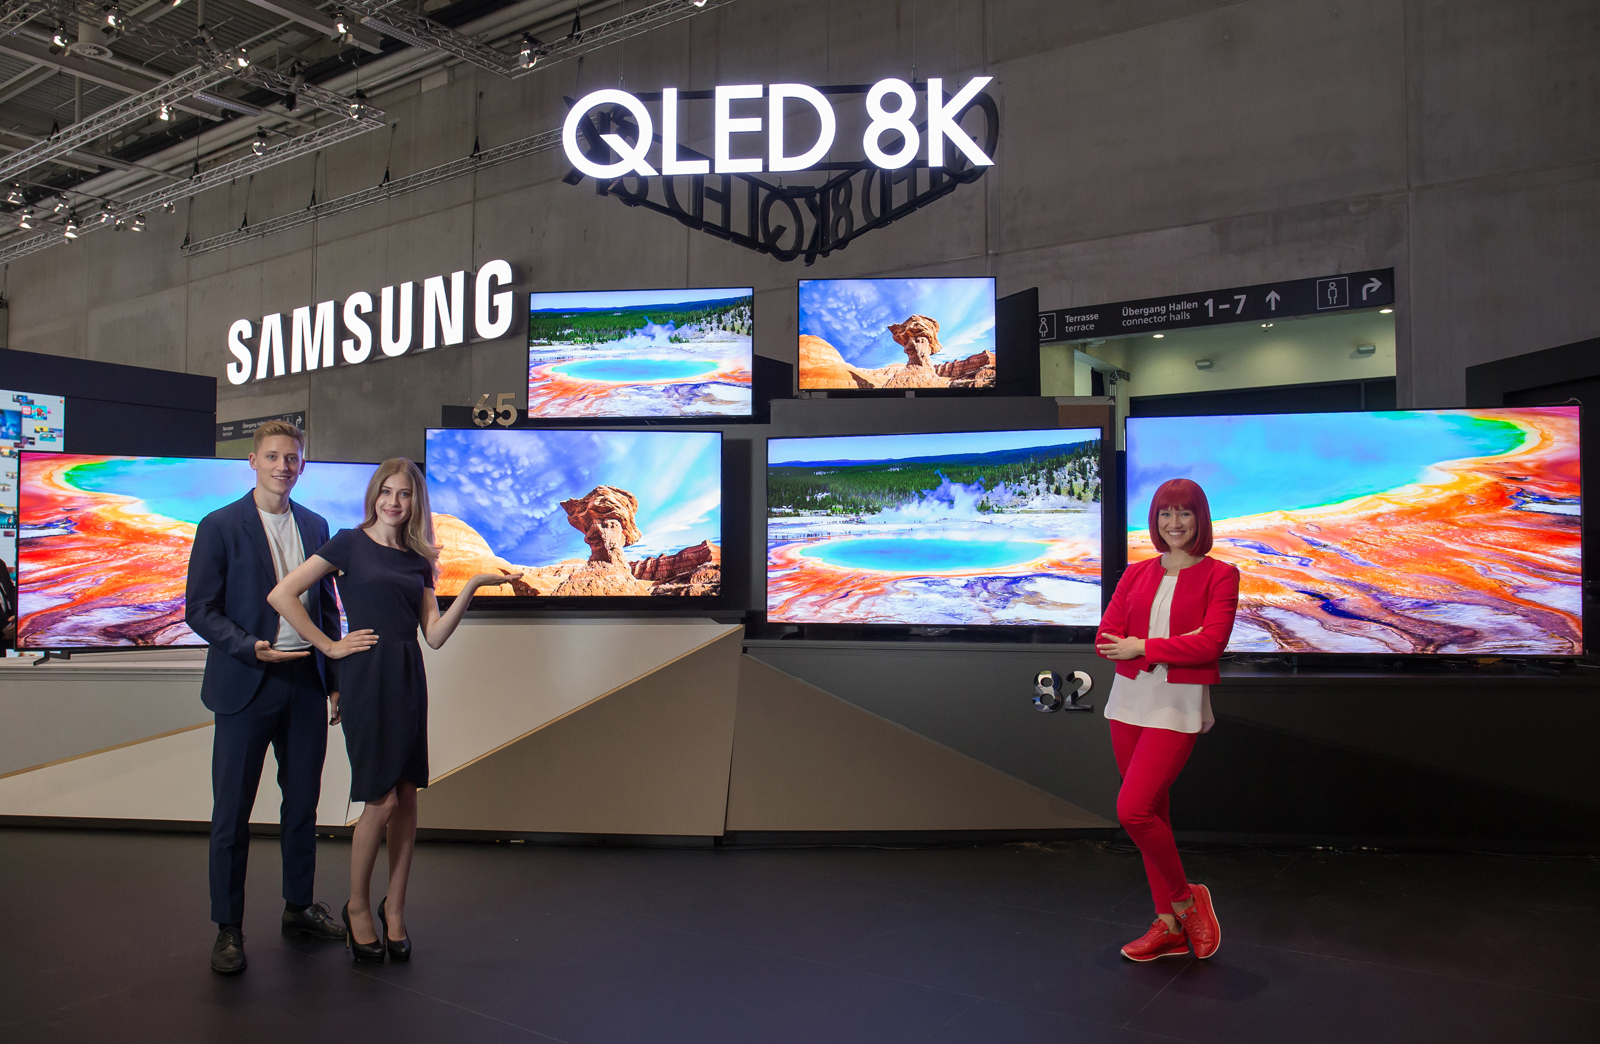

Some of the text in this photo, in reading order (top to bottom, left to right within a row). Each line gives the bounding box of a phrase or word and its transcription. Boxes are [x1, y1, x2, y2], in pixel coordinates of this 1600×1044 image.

[561, 82, 837, 179] QLED
[863, 76, 996, 171] 8K
[1064, 312, 1099, 323] Terrasse
[1121, 300, 1198, 317] Übergang Hallen
[1121, 311, 1191, 327] connector halls
[226, 259, 514, 385] SAMSUNG
[1064, 323, 1095, 333] terrace
[471, 392, 518, 427] 65
[1031, 670, 1093, 713] 82
